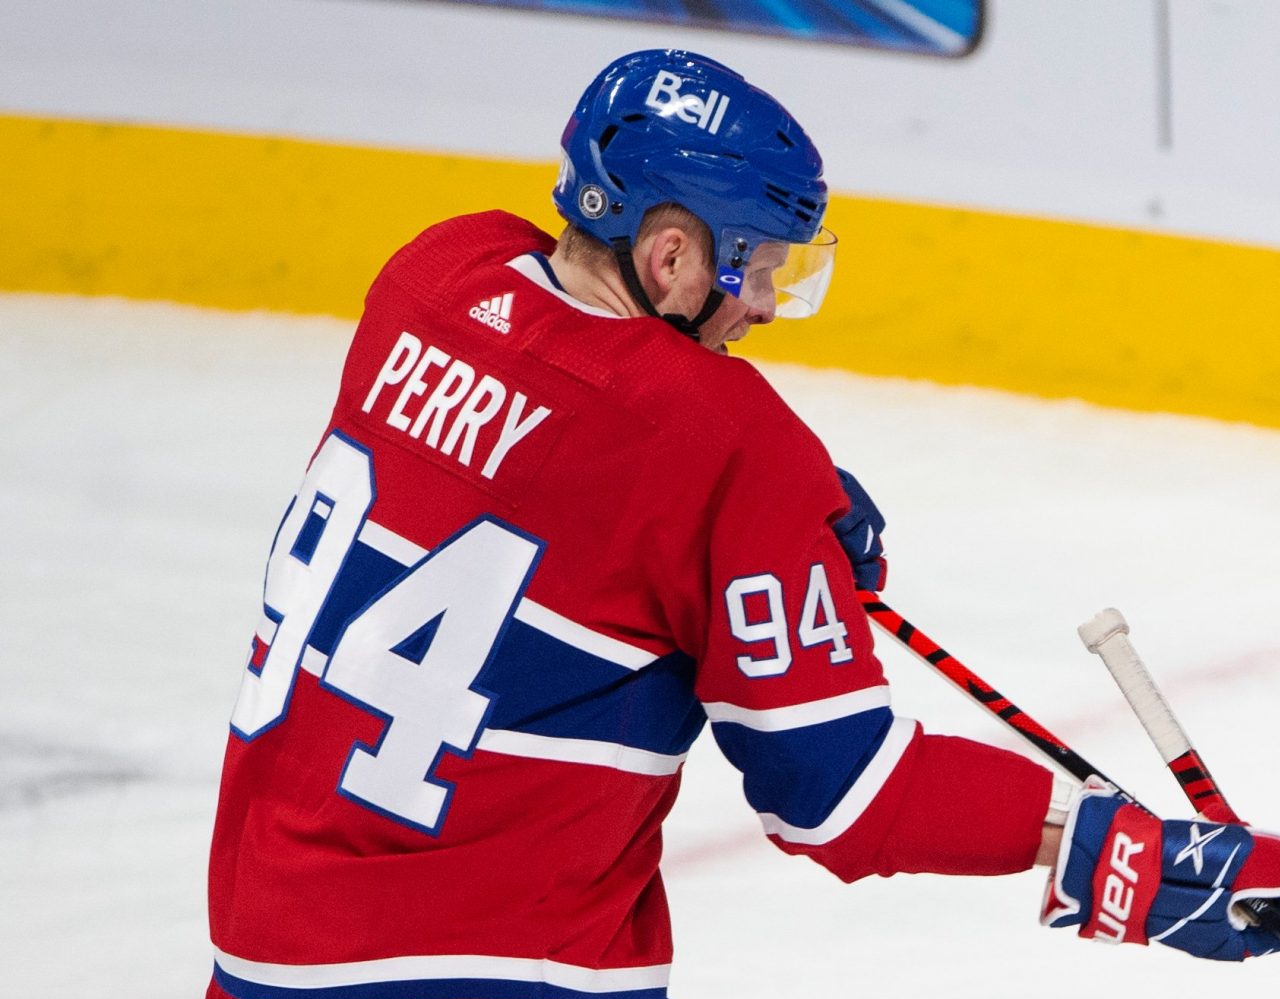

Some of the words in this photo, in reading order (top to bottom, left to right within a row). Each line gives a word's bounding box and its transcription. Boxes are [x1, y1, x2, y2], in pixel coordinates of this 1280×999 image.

[645, 69, 731, 136] Bell
[468, 305, 512, 335] adidas
[361, 330, 552, 480] PERRY
[229, 429, 548, 838] 94
[724, 562, 854, 679] 94
